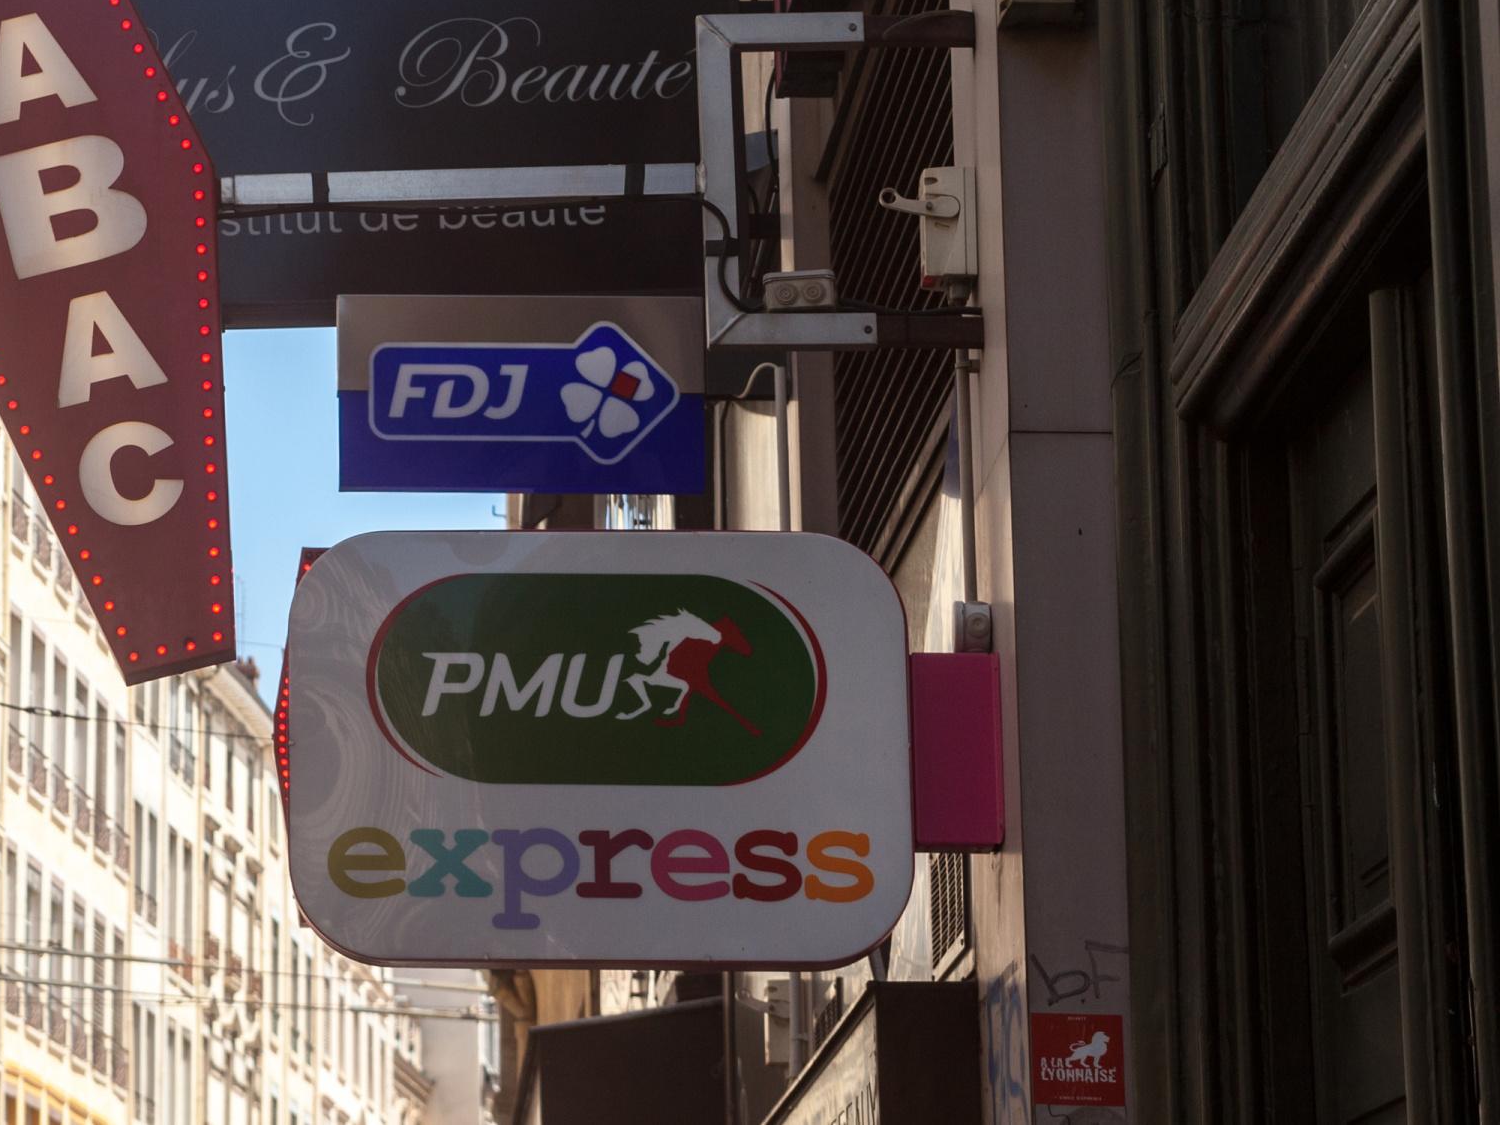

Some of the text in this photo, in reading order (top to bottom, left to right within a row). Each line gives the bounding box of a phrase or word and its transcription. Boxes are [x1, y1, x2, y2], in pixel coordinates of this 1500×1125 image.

[254, 21, 351, 127] &
[394, 17, 697, 109] Beauté
[387, 363, 529, 420] FDJ
[421, 652, 624, 719] PMU
[327, 826, 875, 931] express
[1040, 1066, 1117, 1083] LYONNAISE
[1050, 1056, 1065, 1069] LA
